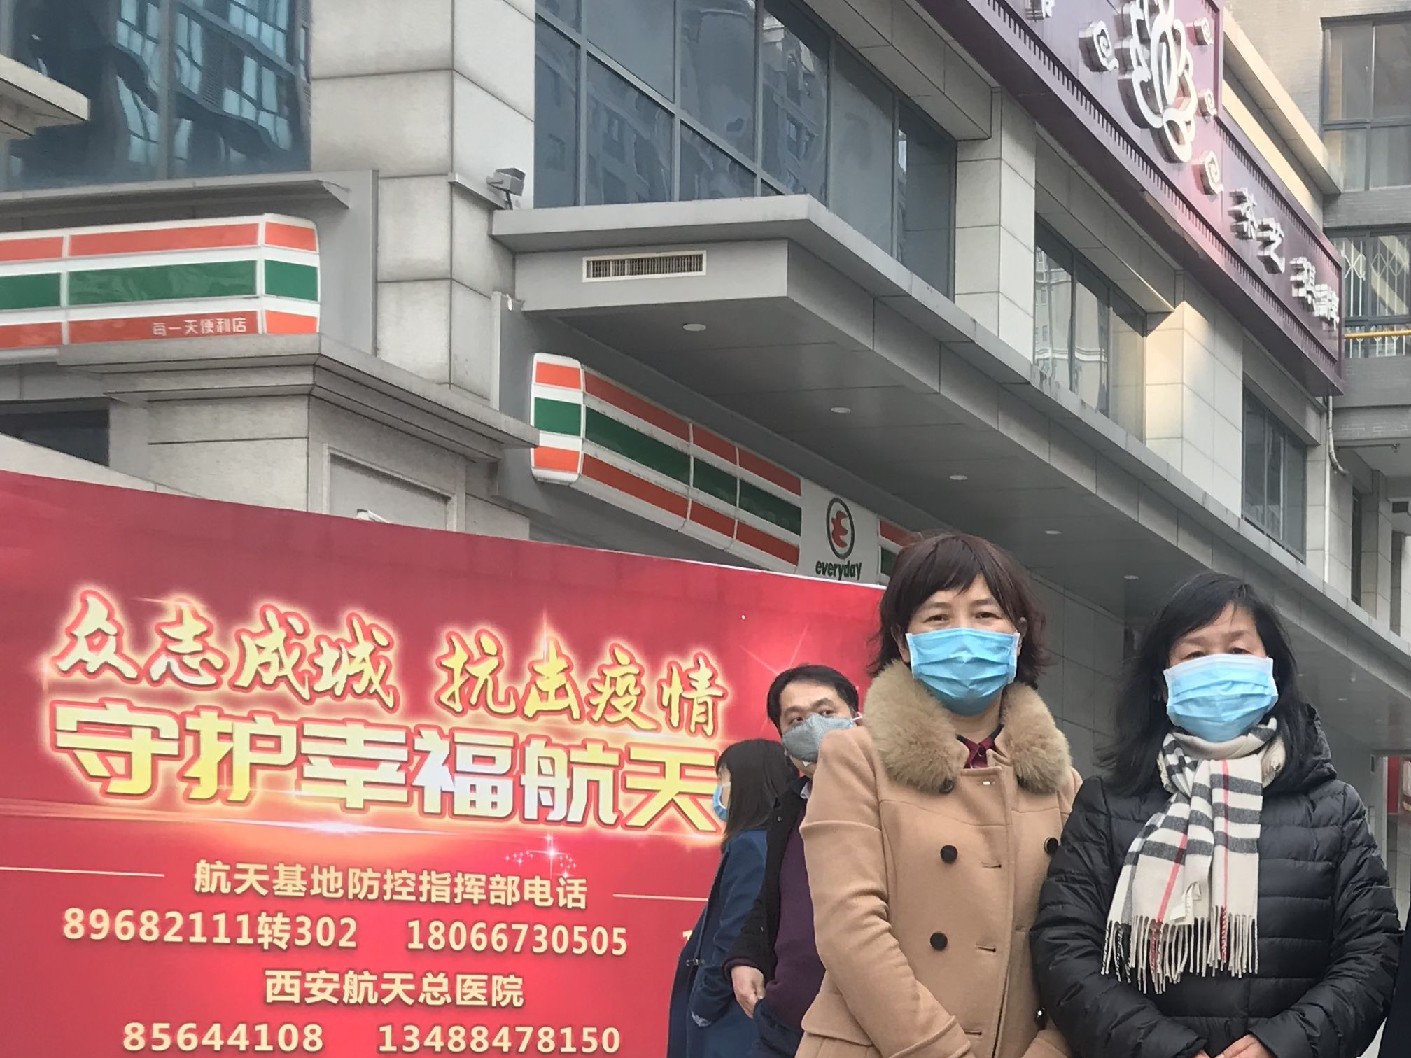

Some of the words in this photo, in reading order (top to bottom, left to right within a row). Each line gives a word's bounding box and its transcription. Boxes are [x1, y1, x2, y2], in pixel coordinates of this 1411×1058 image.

[815, 560, 862, 580] everyday
[57, 591, 397, 707] 众志成城
[438, 628, 726, 738] 抗击疫情
[54, 703, 723, 832] 守护幸福航天
[194, 860, 589, 909] 航天基地防控指挥部电话
[62, 906, 359, 952] 89682111转302
[407, 919, 628, 957] 18066730505
[264, 969, 526, 1008] 西安航天总医院
[121, 1021, 325, 1054] 85644108
[378, 1024, 622, 1056] 13488478150
